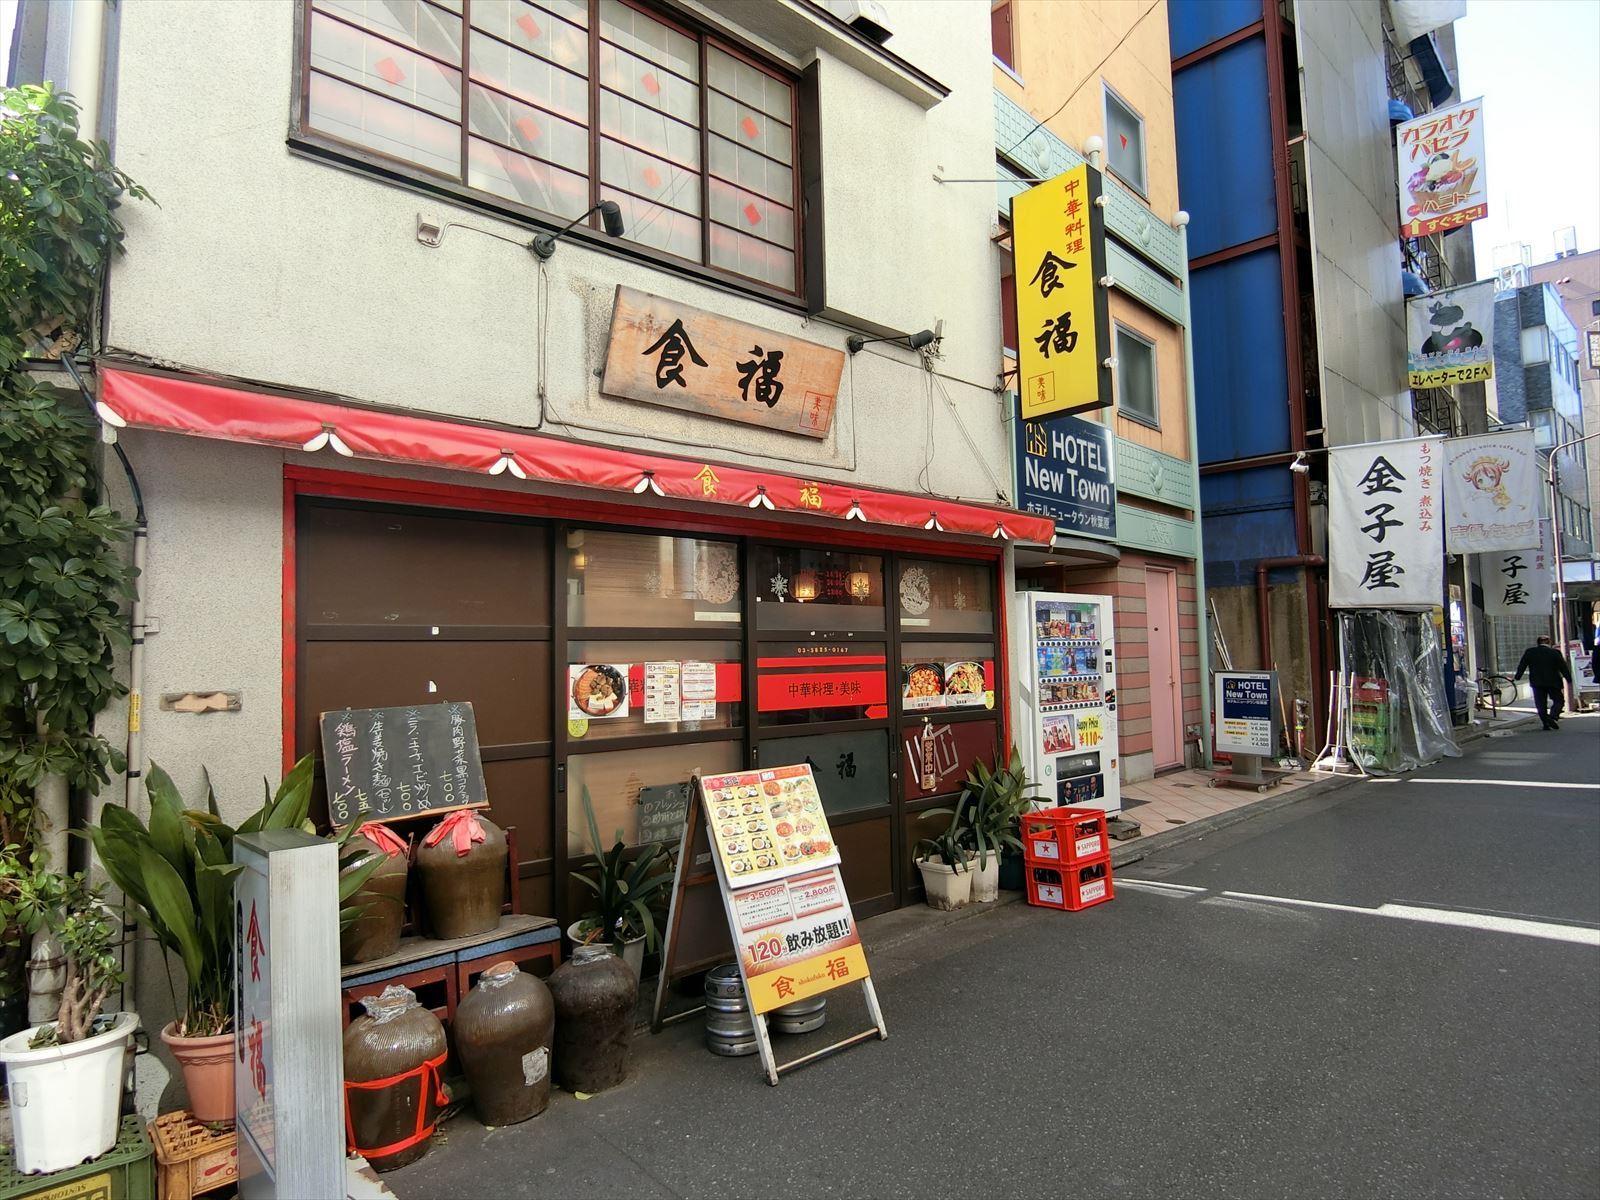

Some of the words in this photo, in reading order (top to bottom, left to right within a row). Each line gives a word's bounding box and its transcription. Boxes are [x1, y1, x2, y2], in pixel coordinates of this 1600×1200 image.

[1401, 108, 1480, 146] カラオケ
[1410, 128, 1470, 161] パセラ
[1063, 179, 1086, 255] 中華料理
[1426, 207, 1483, 232] すぐそこ!
[1029, 250, 1078, 359] 食福
[641, 318, 785, 409] 食福
[1412, 366, 1490, 386] エレベーターで2Fへ
[1052, 430, 1106, 473] HOTEL
[1418, 443, 1432, 489] もつ焼き
[693, 464, 823, 509] 食福
[1025, 457, 1064, 494] New
[1066, 468, 1110, 505] Town
[1356, 455, 1407, 591] 金子屋
[1418, 495, 1432, 532] 煮込み
[1501, 555, 1530, 606] 子屋
[788, 680, 862, 698] 中華料理・美味
[1226, 690, 1244, 698] New
[1245, 691, 1268, 699] Town
[1238, 681, 1268, 691] HOTEL
[924, 739, 935, 776] 営業中
[1080, 840, 1100, 851] SAPPORO
[750, 885, 784, 901] 3,500円
[804, 884, 836, 898] 2,800円
[1084, 883, 1104, 894] SAPPORO
[771, 975, 795, 1000] 食
[826, 956, 850, 981] 福
